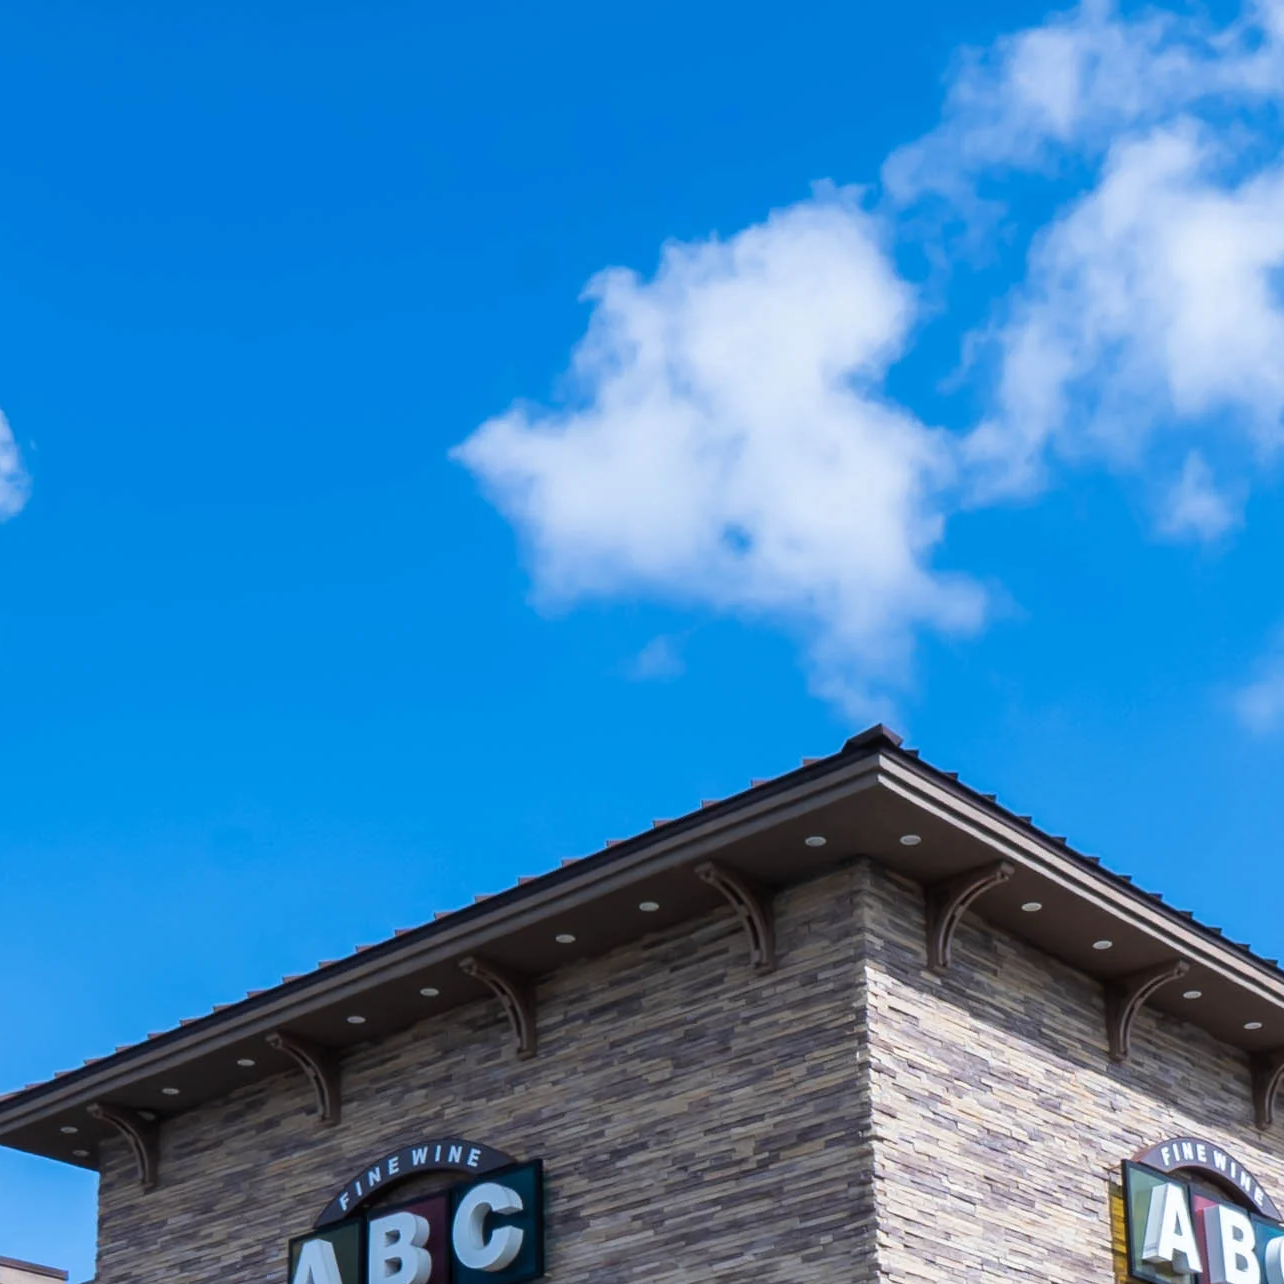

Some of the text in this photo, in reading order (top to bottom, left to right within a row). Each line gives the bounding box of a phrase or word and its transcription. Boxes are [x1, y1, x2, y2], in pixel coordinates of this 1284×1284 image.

[339, 1144, 481, 1211] FINE WINE
[1161, 1142, 1264, 1206] FINE WINE
